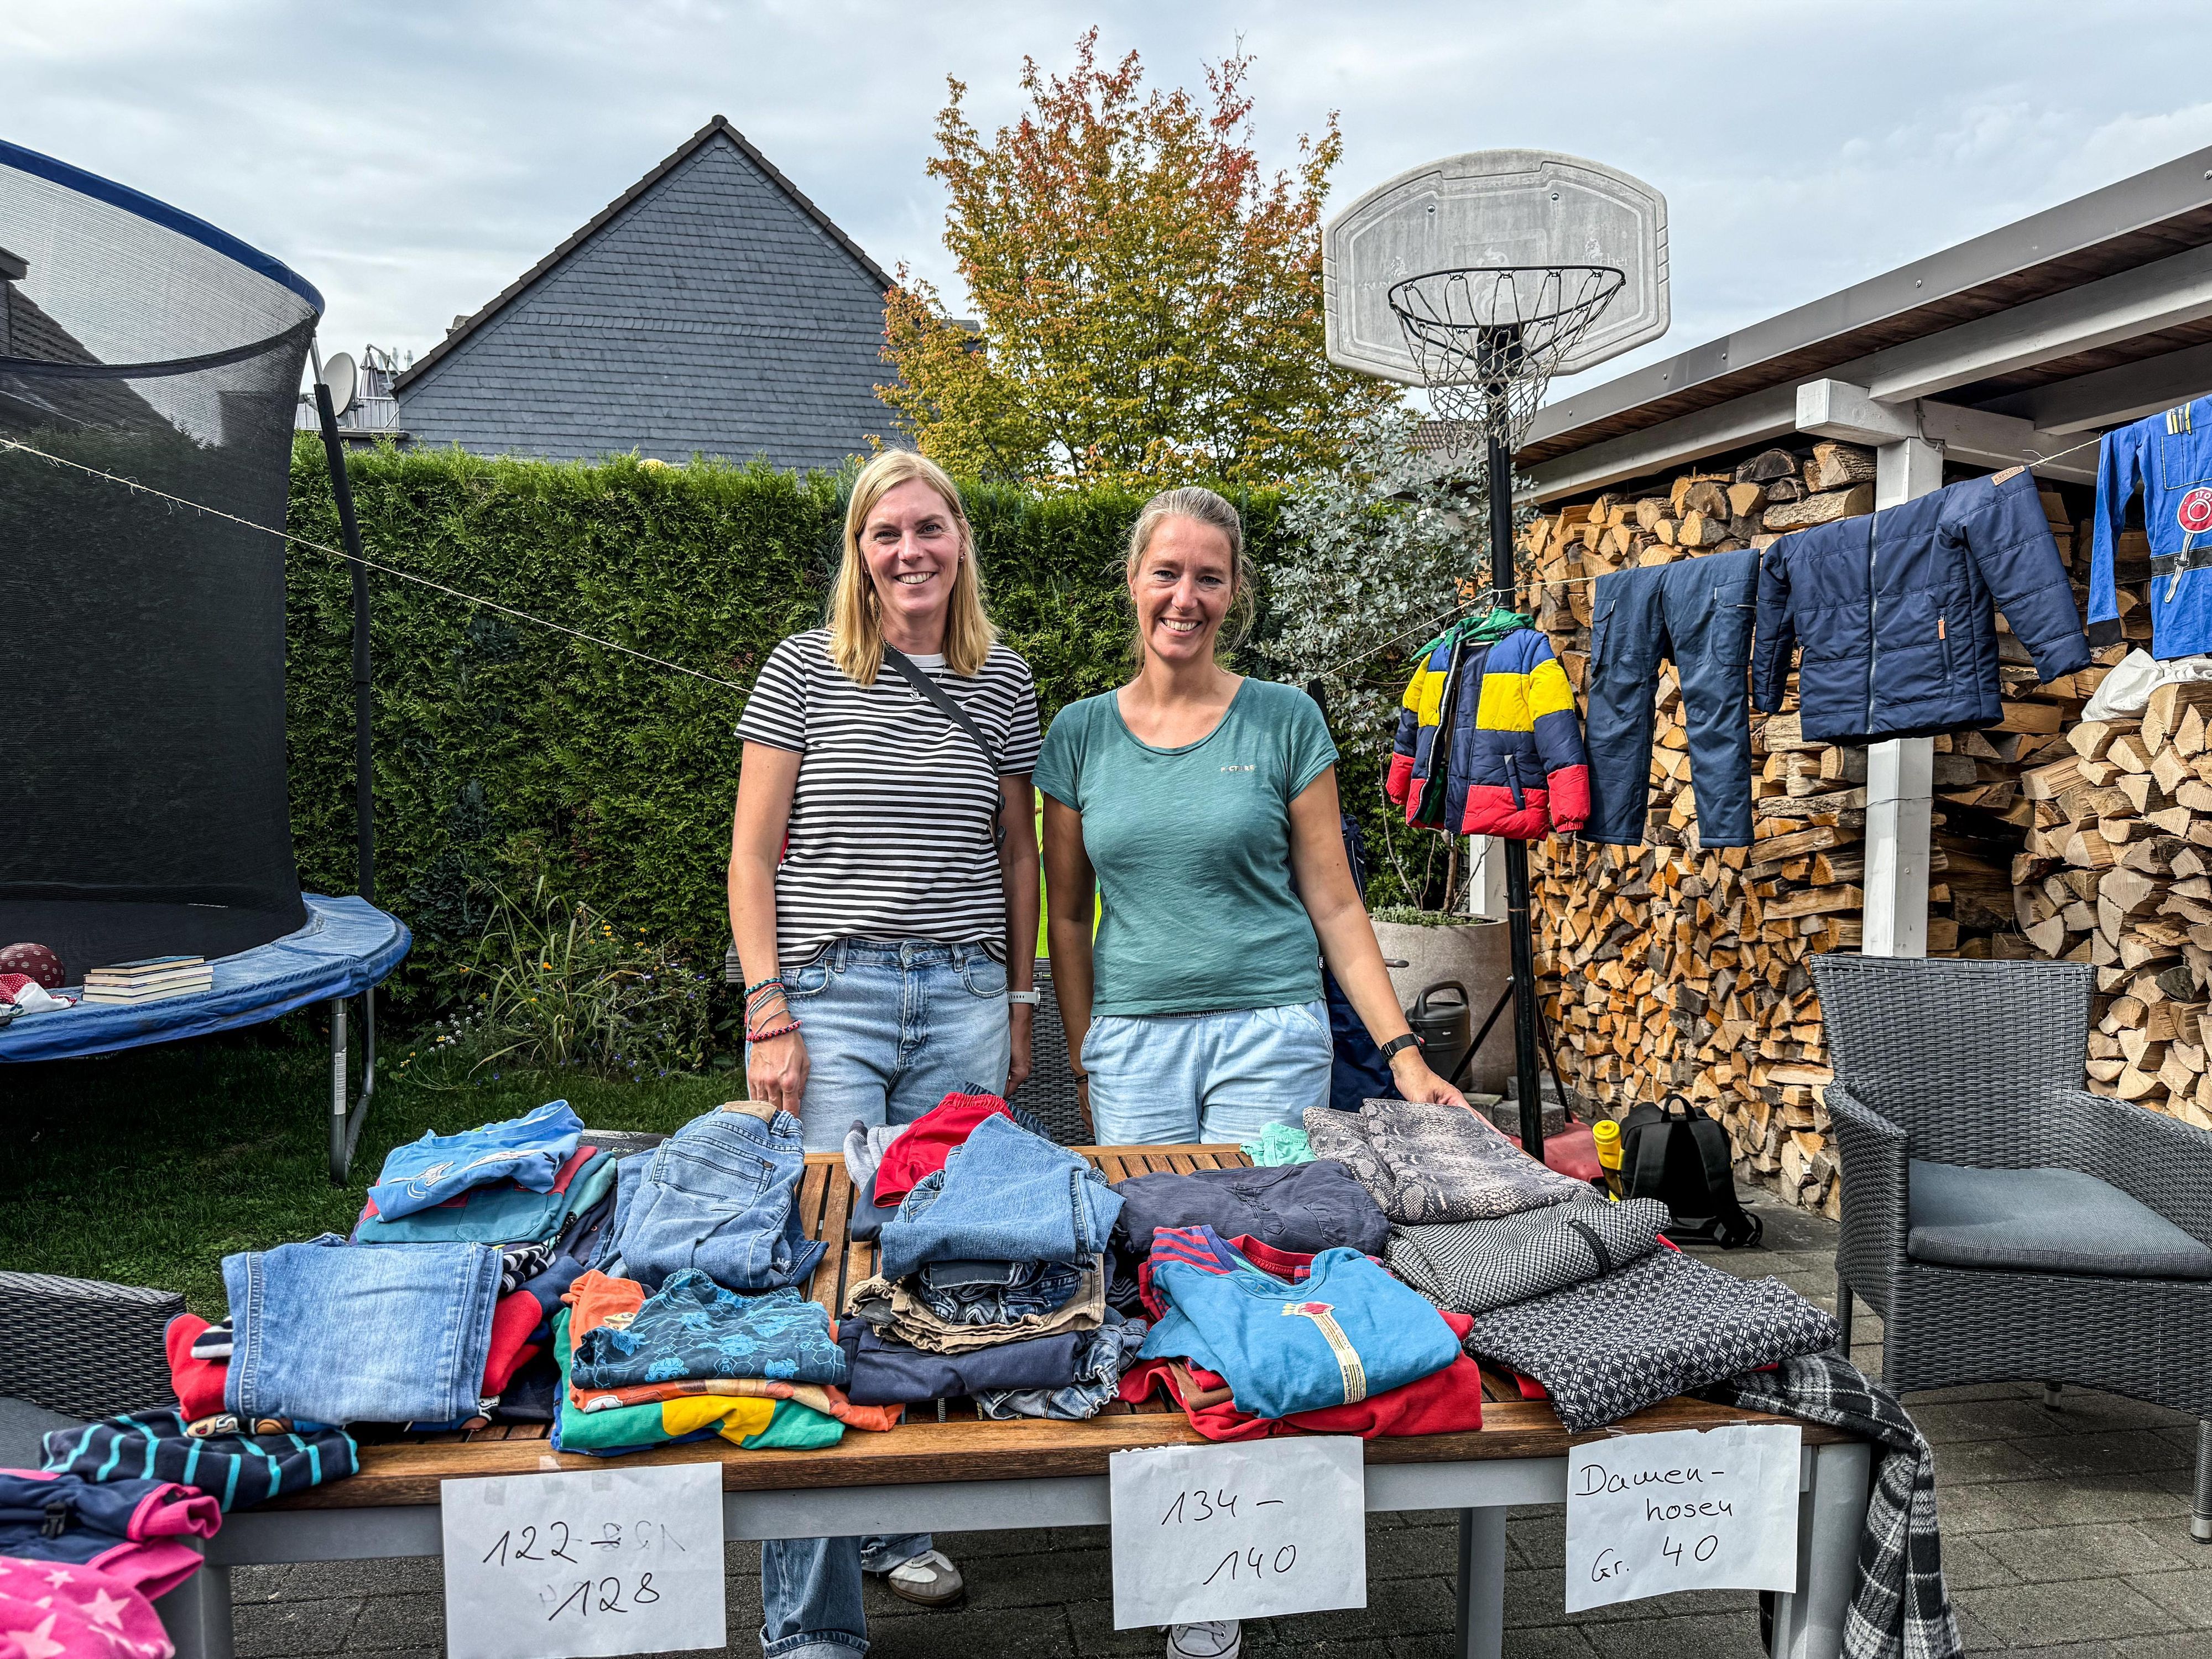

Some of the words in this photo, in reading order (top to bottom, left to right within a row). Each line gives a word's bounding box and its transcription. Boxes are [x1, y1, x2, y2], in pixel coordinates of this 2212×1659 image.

[2195, 490, 2212, 502] STO
[1220, 764, 1255, 773] PICTURE
[1646, 1498, 1733, 1521] hosen
[1203, 1544, 1296, 1585] 140
[1592, 1548, 1629, 1582] Gr.
[1662, 1535, 1719, 1567] 40
[549, 1572, 660, 1621] 128
